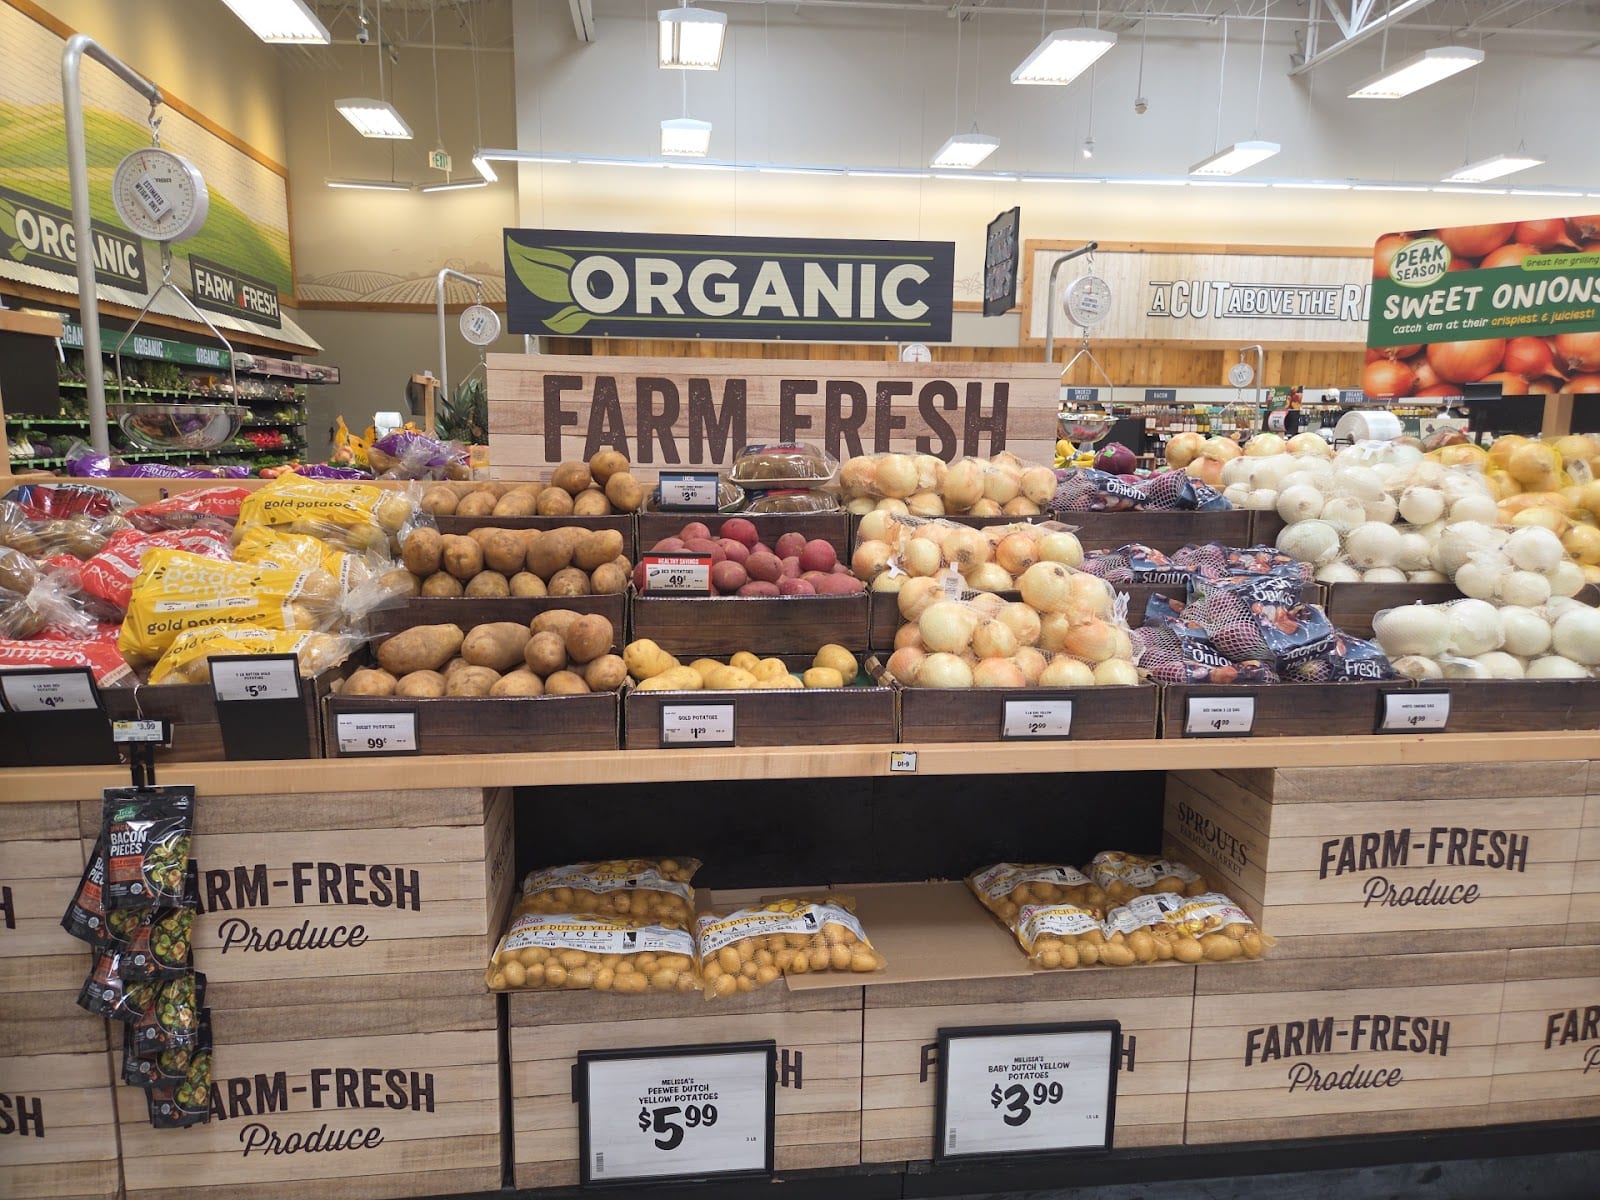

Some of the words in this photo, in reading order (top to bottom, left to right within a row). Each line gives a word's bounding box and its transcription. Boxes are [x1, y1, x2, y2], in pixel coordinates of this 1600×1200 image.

[149, 201, 160, 214] ONLY
[1395, 244, 1444, 268] PEAK
[1526, 258, 1551, 268] Great
[1554, 257, 1568, 265] for
[1569, 256, 1600, 267] grilling
[1396, 262, 1446, 281] SEASON
[195, 269, 235, 302] FARM
[570, 255, 930, 320] ORGANIC
[242, 286, 279, 317] FRESH
[1152, 287, 1166, 311] A
[1170, 280, 1231, 319] CUT
[1228, 288, 1293, 314] ABOVE
[1299, 290, 1338, 315] THE
[1383, 286, 1483, 320] SWEET
[1492, 276, 1600, 309] ONIONS
[1393, 324, 1422, 334] Catch
[1446, 321, 1458, 330] at
[1462, 318, 1488, 328] their
[1491, 314, 1538, 327] crispiest
[1550, 308, 1596, 324] juiciest!
[60, 325, 84, 346] RGAN
[134, 337, 164, 358] ORGANIC
[196, 348, 220, 366] ORGANIC
[543, 374, 748, 465] FARM
[780, 378, 1010, 464] FRESH
[264, 500, 294, 510] gold
[163, 567, 255, 586] potato
[147, 618, 183, 635] gold
[1344, 659, 1382, 678] Fresh
[110, 831, 148, 845] BACON
[1178, 801, 1248, 866] SPROUTS
[110, 843, 143, 857] PIECES
[1210, 847, 1241, 877] MARKET
[1318, 827, 1529, 880] FARM-FRESH
[196, 862, 421, 915] RM-FRESH
[1362, 875, 1481, 908] Produce
[218, 918, 370, 954] Produce
[516, 931, 613, 939] OTATOES
[1244, 1014, 1450, 1067] FARM-FRESH
[988, 1064, 1009, 1073] BABY
[1011, 1063, 1037, 1072] DUTCH
[1039, 1062, 1070, 1071] YELLOW
[1008, 1071, 1049, 1080] POTATOES
[1287, 1062, 1403, 1093] Produce
[208, 1067, 435, 1123] ARM-FRESH
[639, 1095, 672, 1104] YELLOW
[674, 1092, 719, 1102] POTATOES
[648, 1086, 679, 1095] PEEWEE
[682, 1084, 709, 1093] DUTCH
[239, 1122, 385, 1157] Produce
